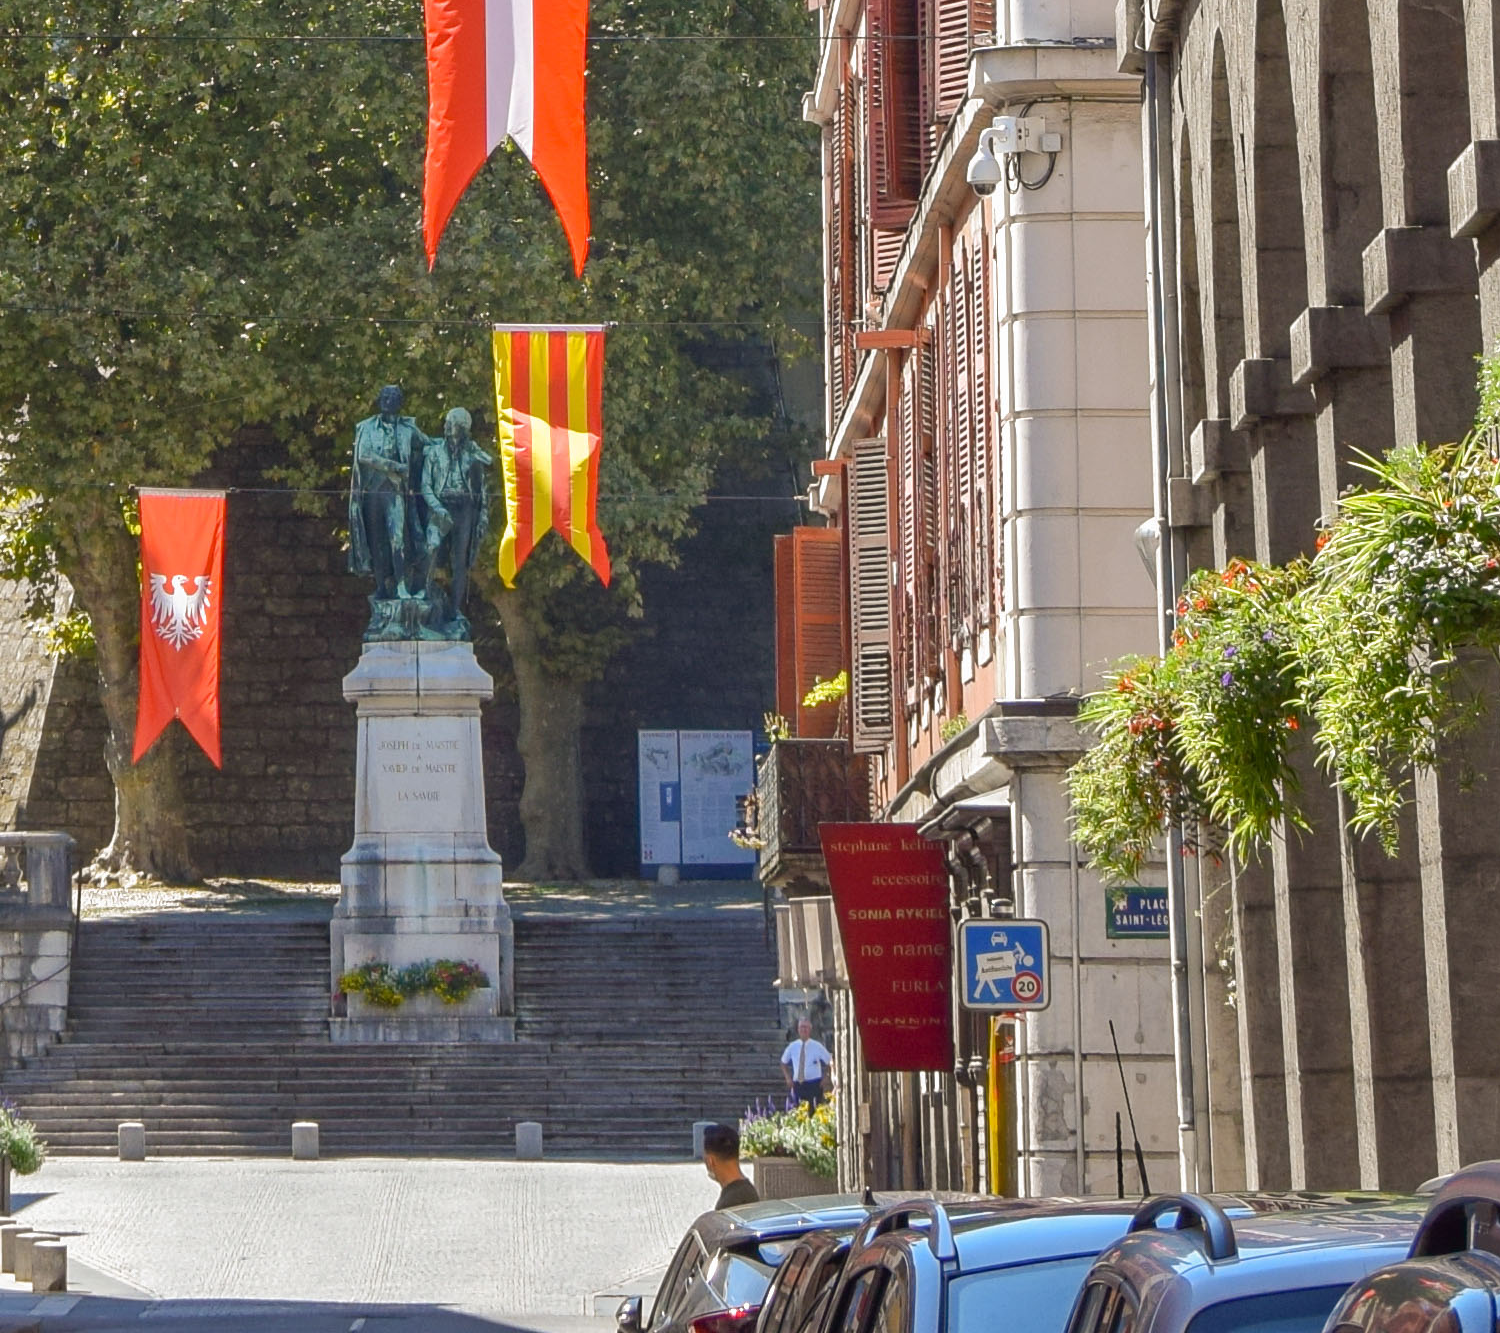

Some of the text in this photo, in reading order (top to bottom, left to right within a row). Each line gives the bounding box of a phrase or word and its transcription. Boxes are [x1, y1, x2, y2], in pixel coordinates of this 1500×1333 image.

[848, 908, 946, 920] SONIA RYKIEL
[1115, 913, 1168, 926] SAINT-LÉG
[893, 943, 945, 957] name
[892, 980, 945, 993] FURLA
[1018, 980, 1035, 992] 20
